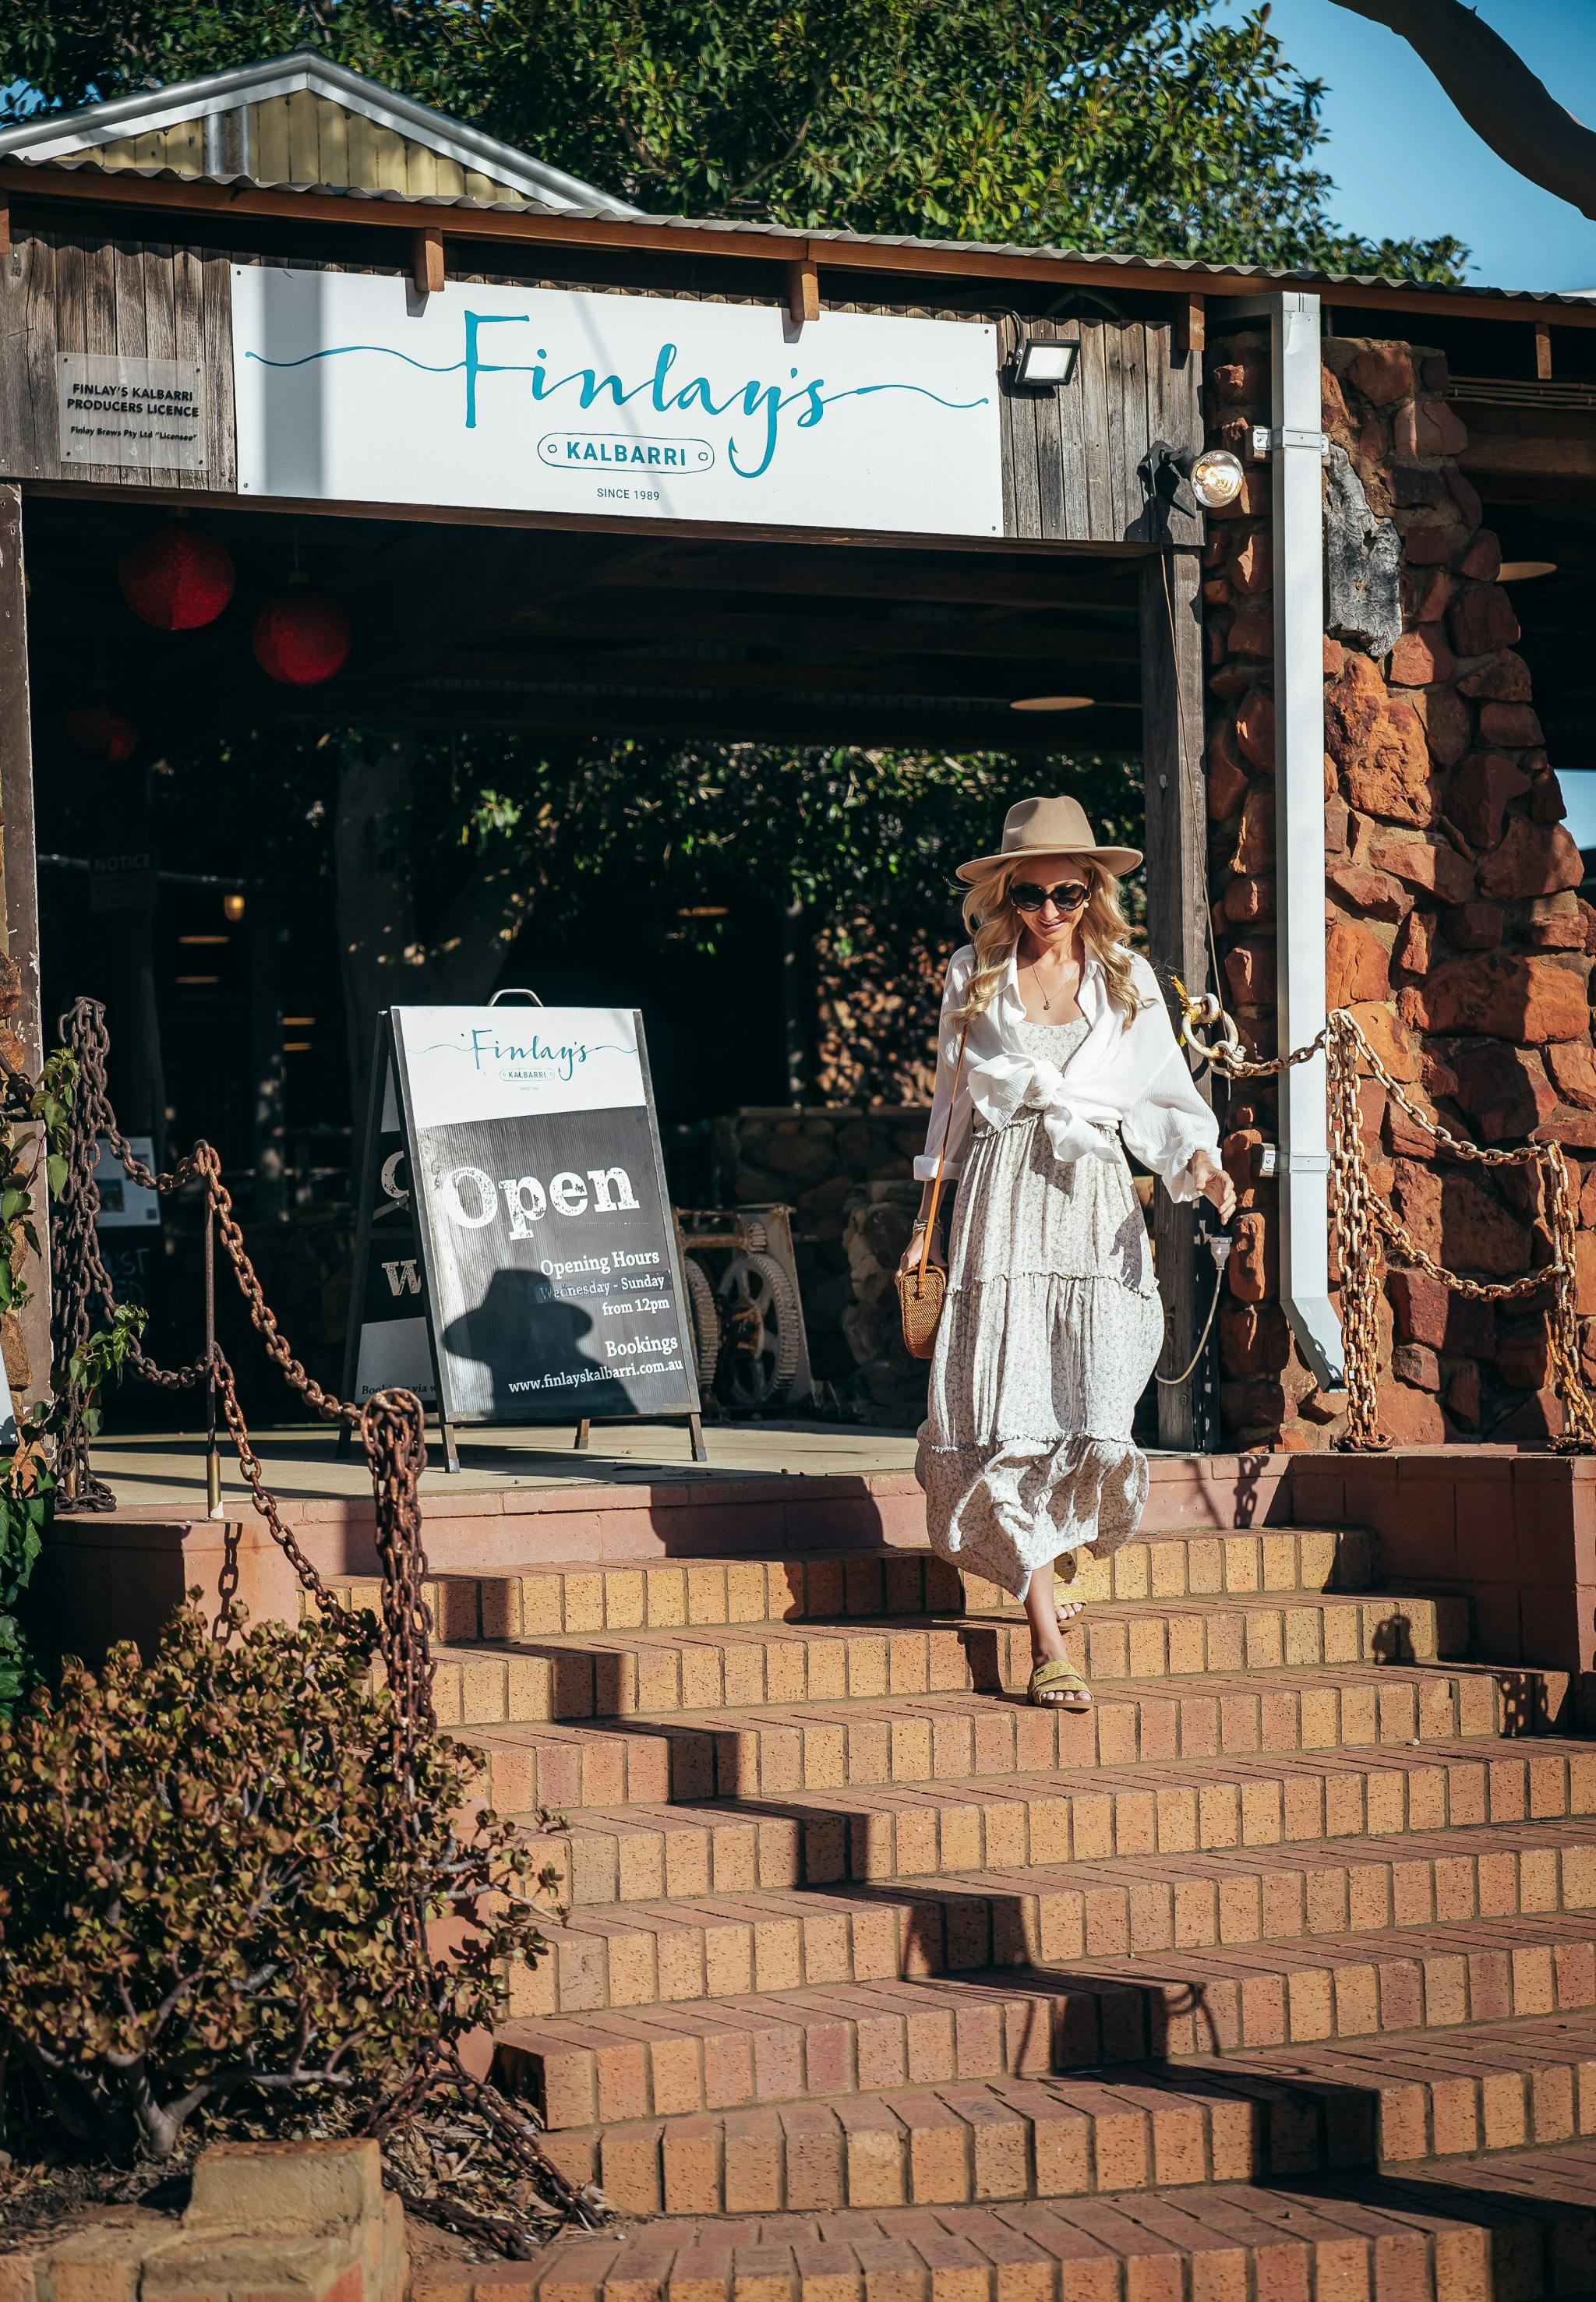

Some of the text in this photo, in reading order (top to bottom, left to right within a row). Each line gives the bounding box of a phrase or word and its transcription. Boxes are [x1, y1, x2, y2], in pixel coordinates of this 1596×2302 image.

[72, 383, 193, 402] FINLAY'S KALBARRI
[464, 309, 824, 478] Finlay's
[67, 398, 200, 418] PRODUCERS LICENCE
[71, 426, 95, 436] Finlay
[97, 428, 122, 437] Brews
[123, 429, 138, 439] Pty
[567, 441, 686, 466] KALBARRI
[597, 488, 660, 501] SINCE 1989
[94, 853, 150, 874] NOTICE
[471, 1029, 588, 1082] Finlay's
[440, 1167, 641, 1241] Open
[540, 1250, 660, 1279] Opening Hours
[539, 1281, 610, 1300] Wednesday
[621, 1274, 665, 1290] Sunday
[602, 1298, 670, 1316] from 12pm
[605, 1336, 678, 1357] Bookings
[508, 1360, 683, 1393] www.finlayskalbarri.com.au
[412, 1384, 428, 1393] via
